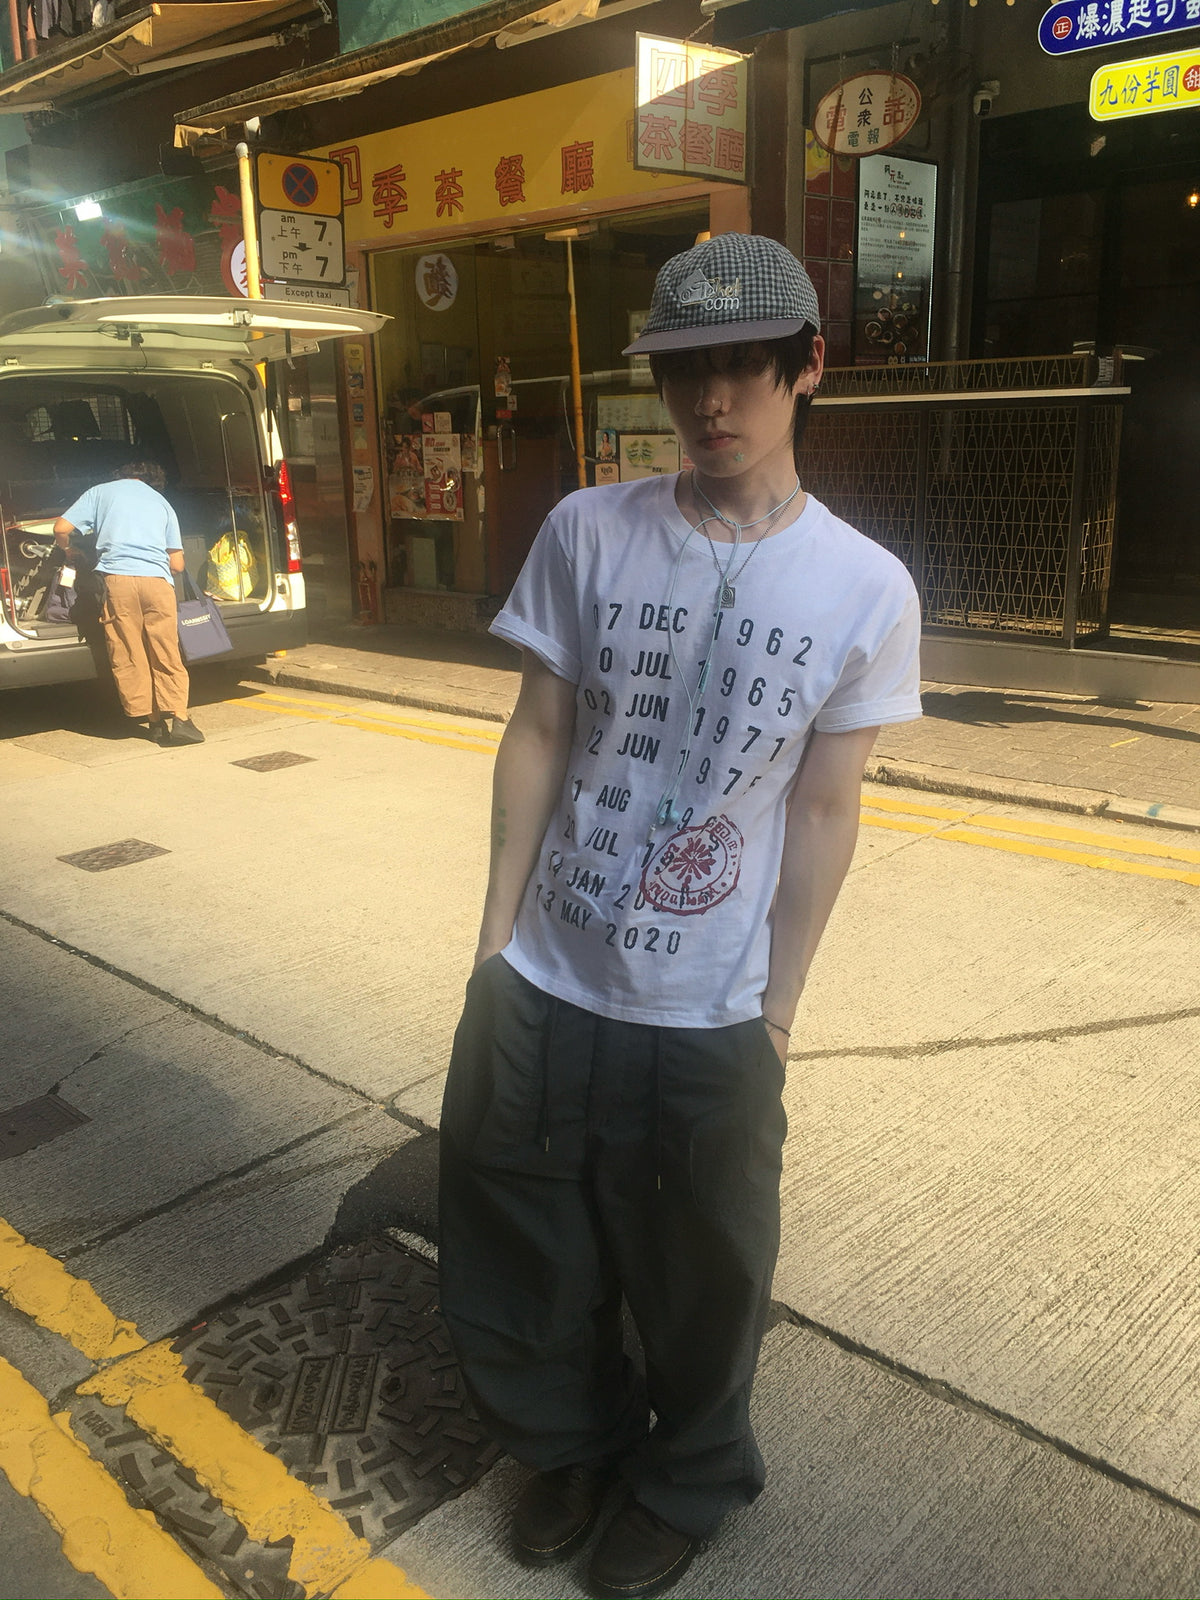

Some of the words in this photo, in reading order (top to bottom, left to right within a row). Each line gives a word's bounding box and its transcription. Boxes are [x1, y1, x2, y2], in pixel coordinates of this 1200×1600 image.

[1056, 22, 1069, 35] 正
[650, 48, 738, 116] 四季
[1100, 65, 1180, 106] 九份芋圓
[639, 113, 745, 173] 茶餐廳
[277, 225, 301, 239] 上午
[281, 215, 295, 223] am
[314, 221, 327, 242] 7
[279, 262, 302, 275] 下午
[282, 250, 298, 262] pm
[315, 256, 329, 277] 7
[286, 288, 313, 298] Except
[317, 291, 332, 299] taxi
[705, 297, 740, 311] com
[639, 603, 688, 633] DEC
[631, 651, 672, 680] JUL
[584, 688, 611, 716] 02
[625, 693, 670, 722] JUN
[693, 706, 786, 762] 1971
[617, 733, 661, 764] JUN
[595, 784, 632, 813] AUG
[585, 826, 619, 857] JUL
[566, 867, 606, 898] JAN
[560, 899, 593, 931] MAY
[605, 923, 681, 955] 2020
